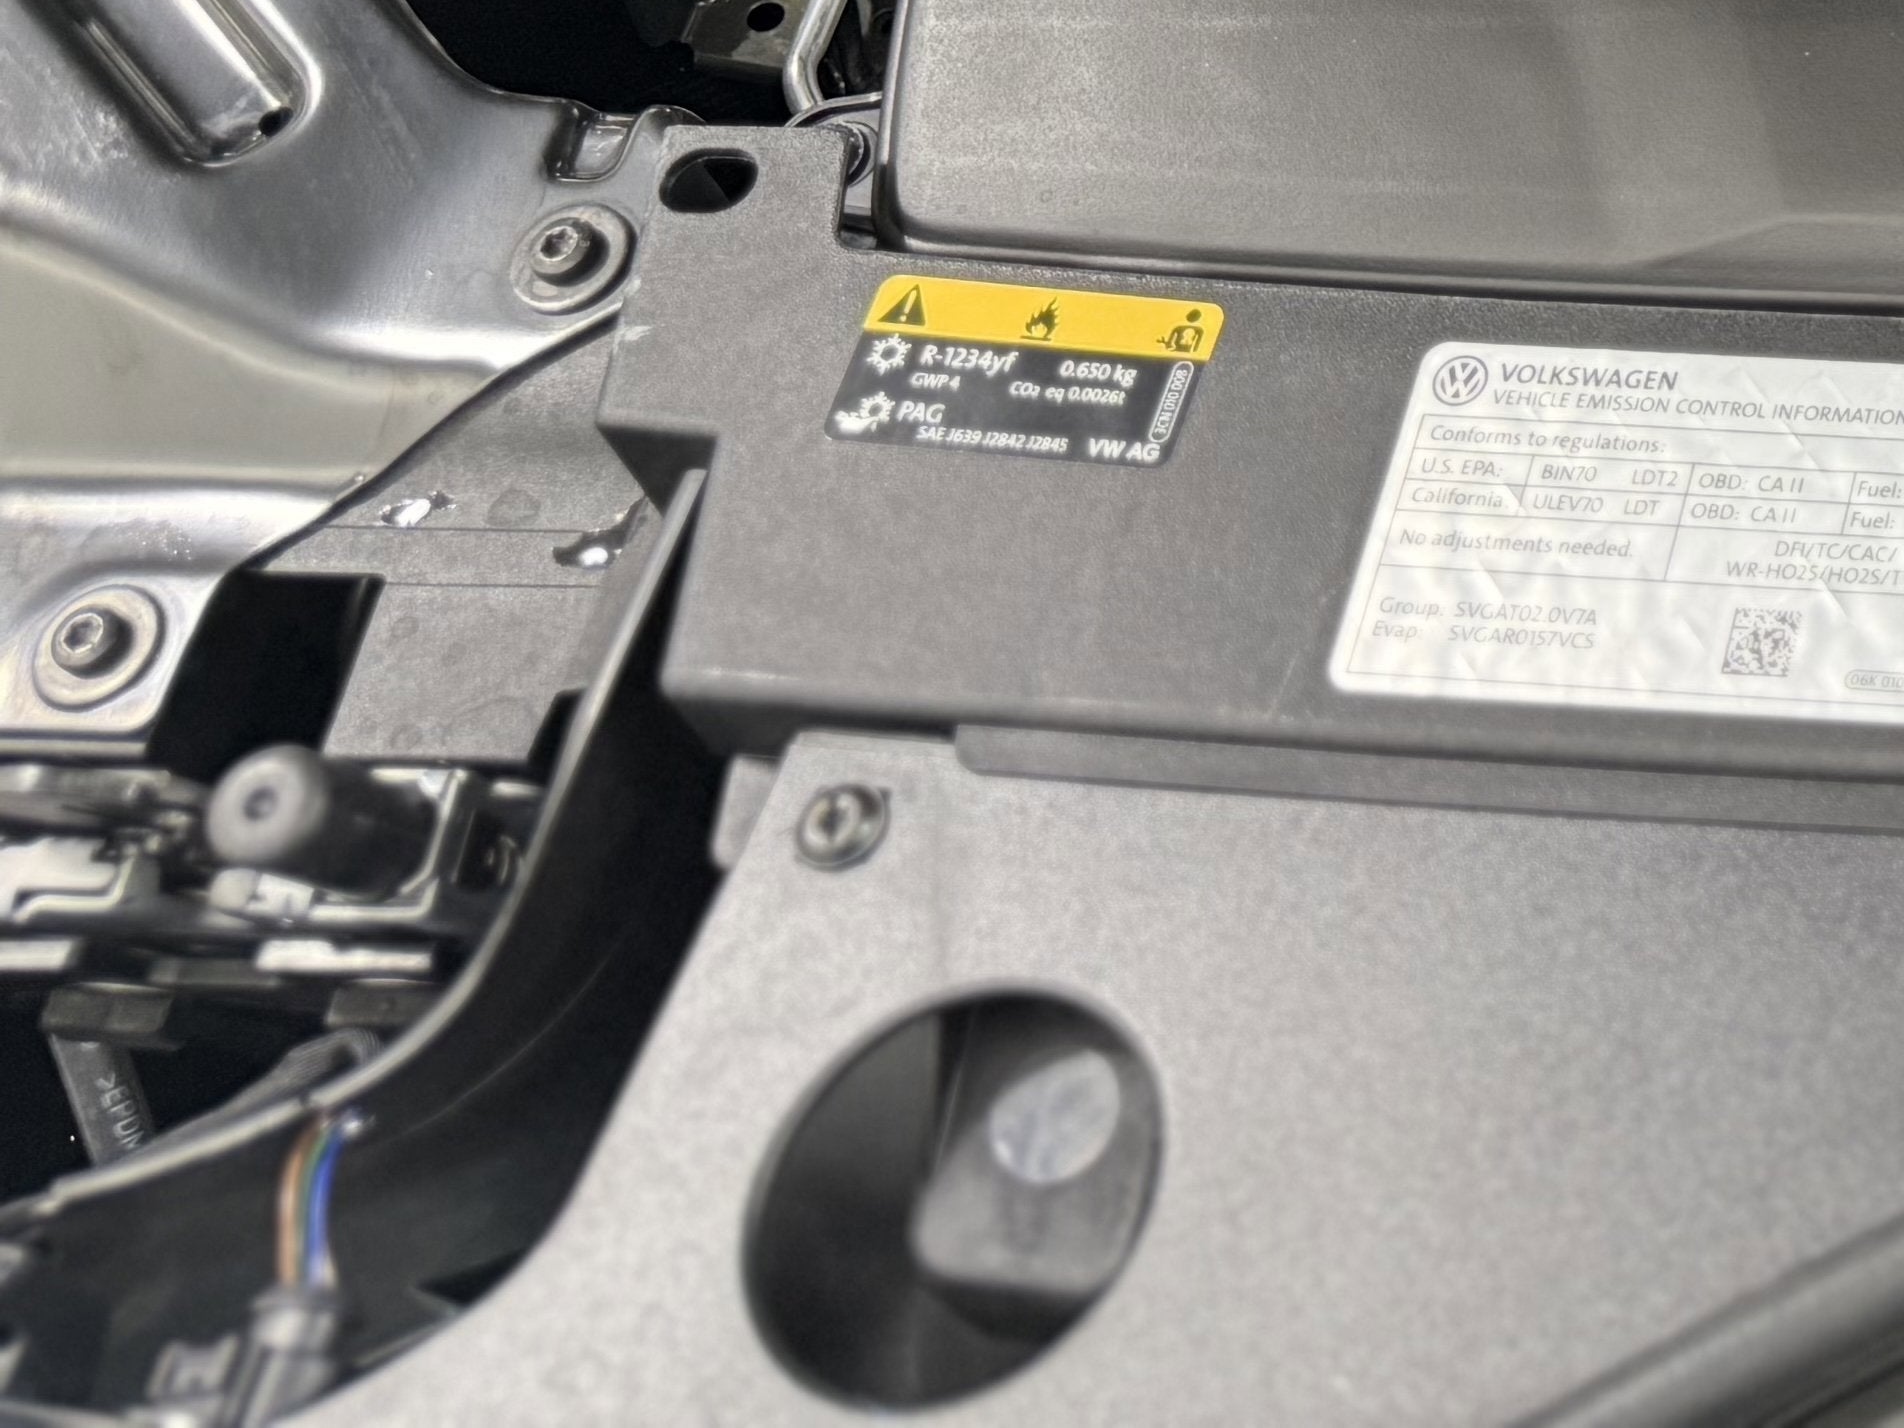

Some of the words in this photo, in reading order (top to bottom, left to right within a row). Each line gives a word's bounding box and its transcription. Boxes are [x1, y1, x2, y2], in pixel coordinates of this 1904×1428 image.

[919, 343, 1020, 378] R-1234yf
[1058, 359, 1112, 382] 0.650
[1113, 362, 1139, 389] kg
[1500, 362, 1679, 391] VOLKSWAGEN
[909, 371, 948, 389] GWP
[1044, 387, 1064, 406] eq
[1493, 388, 1570, 408] VEHICLE
[1575, 394, 1671, 414] EMISSION
[1675, 398, 1766, 420] CONTROL
[896, 399, 946, 425] PAG
[915, 424, 947, 442] SAE
[1430, 424, 1521, 447] Conforms
[1527, 429, 1548, 448] to
[1552, 432, 1666, 455] regulations:
[1087, 437, 1123, 459] VW
[1126, 441, 1161, 463] AG
[1420, 457, 1455, 475] U.S.
[1460, 459, 1504, 478] EPA:
[1540, 463, 1598, 483] BIN70
[1630, 469, 1679, 487] LDT2
[1698, 473, 1747, 491] OBD:
[1856, 480, 1903, 500] Fuel:
[1532, 492, 1605, 514] ULEV70
[1624, 498, 1661, 516] LDT
[1690, 502, 1741, 522] OBD:
[1849, 511, 1895, 531] Fuel:
[1399, 527, 1427, 546] No
[1432, 529, 1553, 554] adjustments
[1557, 539, 1633, 559] needed.
